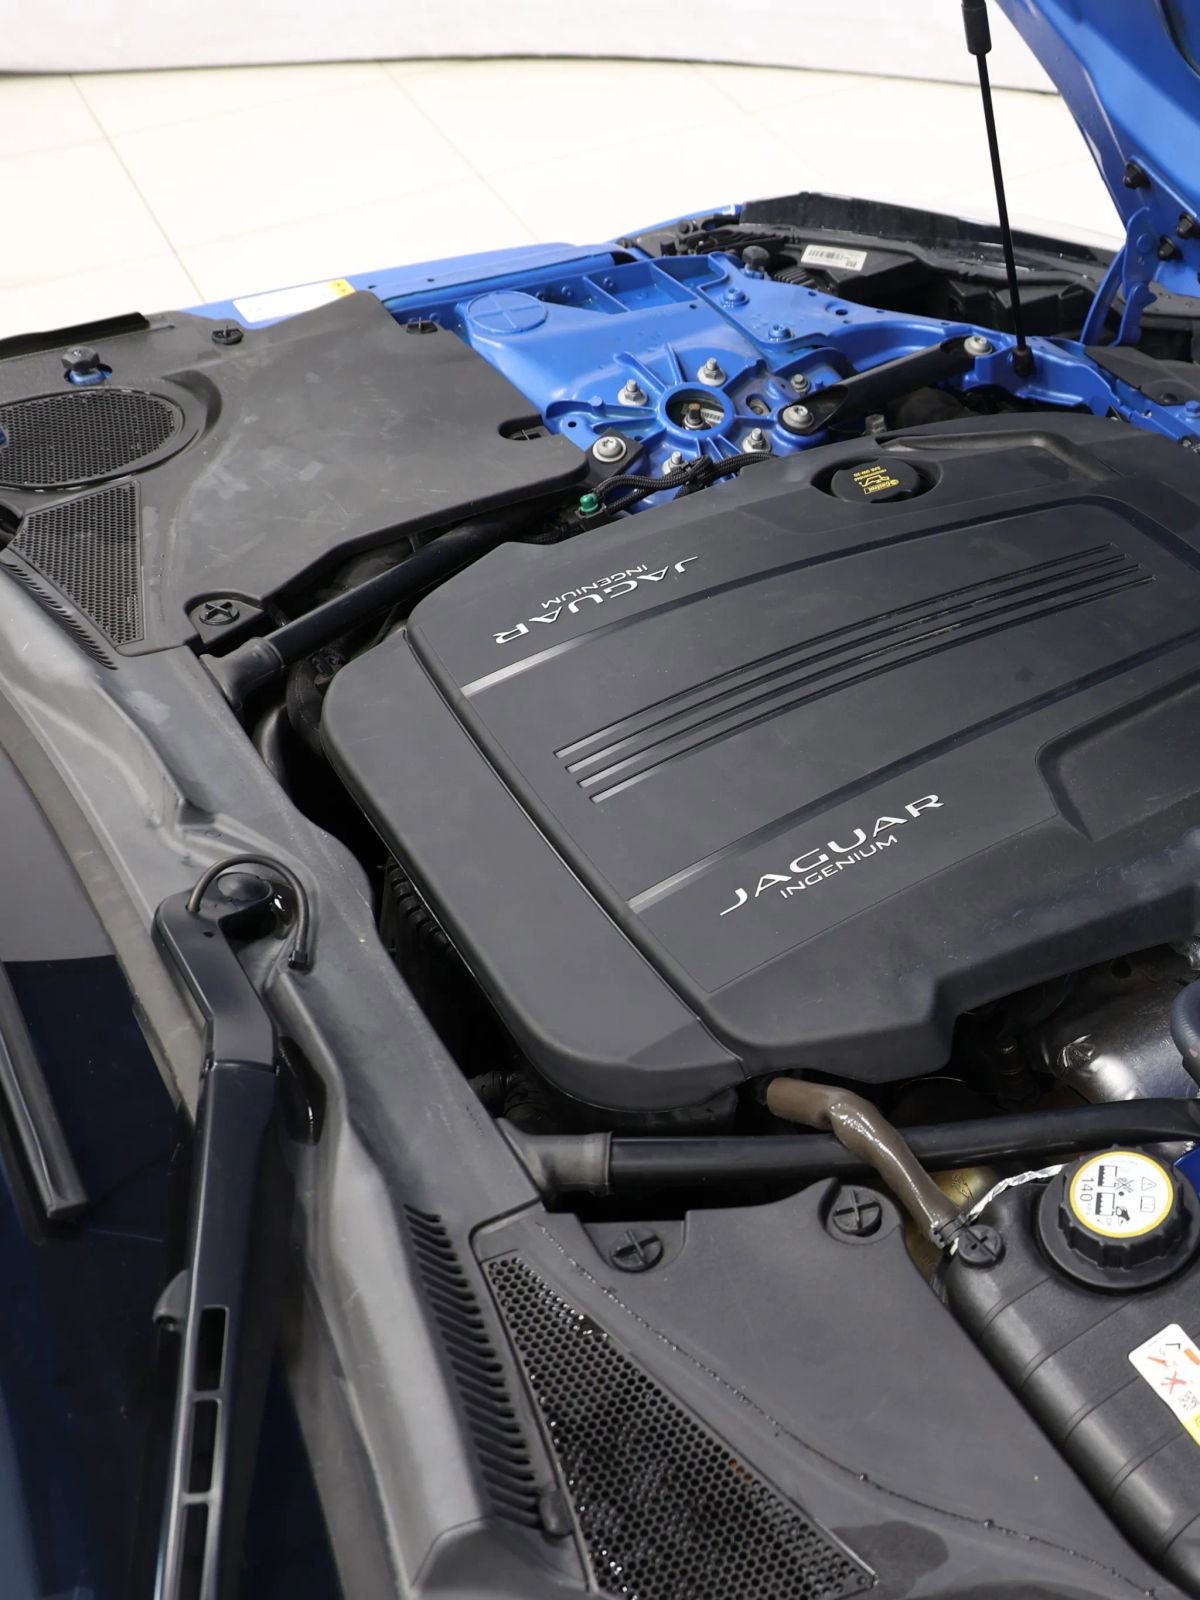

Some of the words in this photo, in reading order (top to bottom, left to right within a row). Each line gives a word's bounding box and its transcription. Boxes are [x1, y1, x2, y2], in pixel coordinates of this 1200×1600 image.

[493, 556, 698, 644] JAGUAR
[541, 564, 648, 609] INGENIUM
[720, 794, 944, 916] JAGUAR
[780, 834, 898, 899] INGENIUM
[1080, 1177, 1094, 1202] 140
